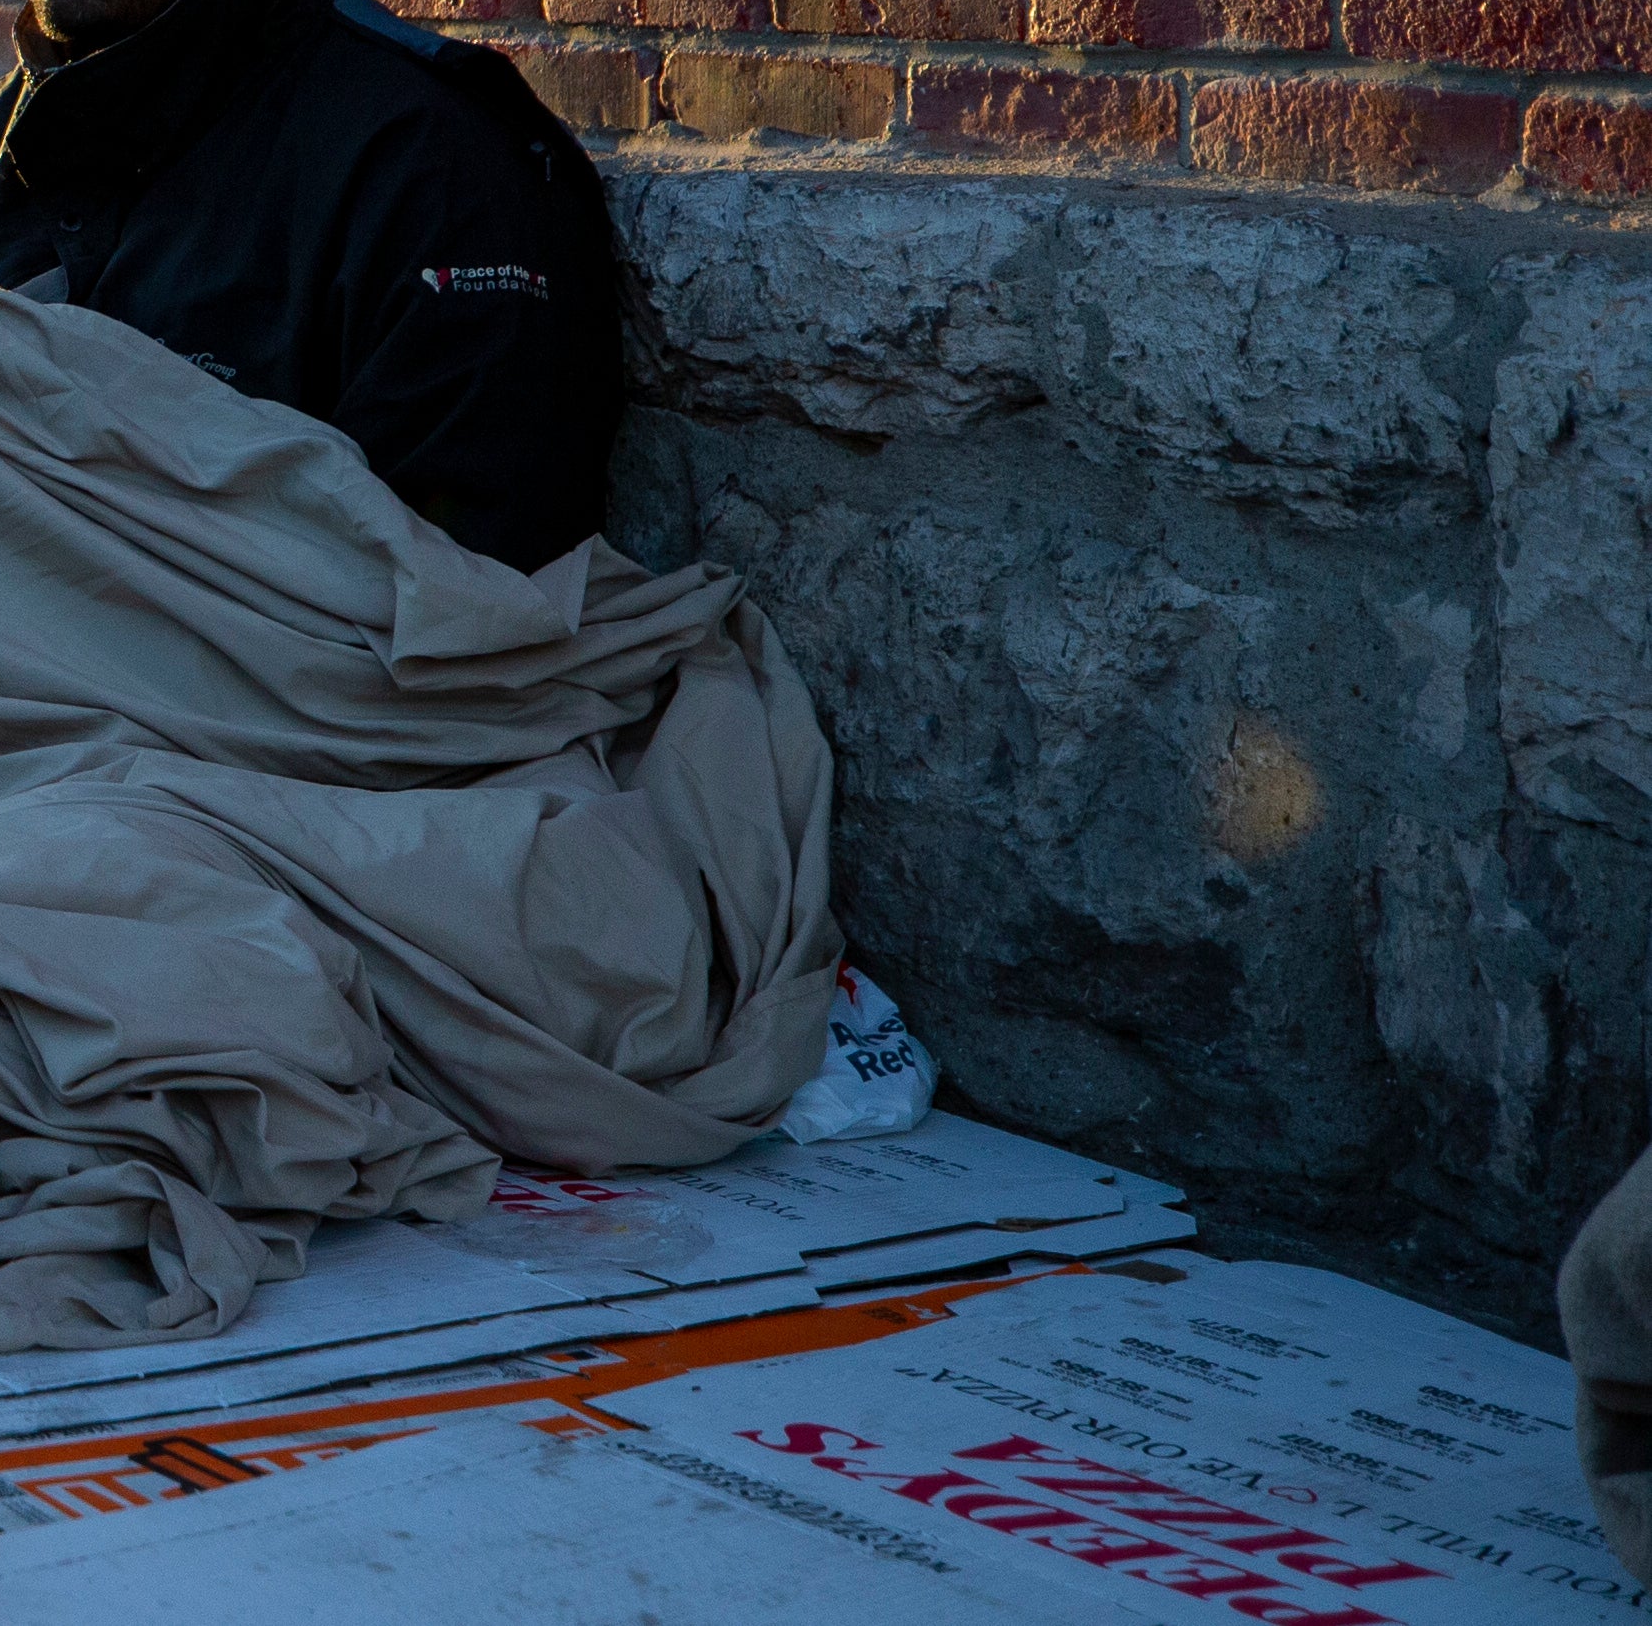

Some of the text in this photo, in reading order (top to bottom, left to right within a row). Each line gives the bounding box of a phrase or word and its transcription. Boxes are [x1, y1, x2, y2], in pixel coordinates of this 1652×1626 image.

[450, 267, 495, 279] Peace
[498, 264, 511, 276] of
[453, 279, 548, 300] Foundation
[197, 352, 237, 380] Group
[1073, 1417, 1188, 1459] OUR
[733, 1422, 1410, 1626] PEEDY'S
[953, 1433, 1454, 1587] PIZZA
[1380, 1514, 1514, 1566] WILL
